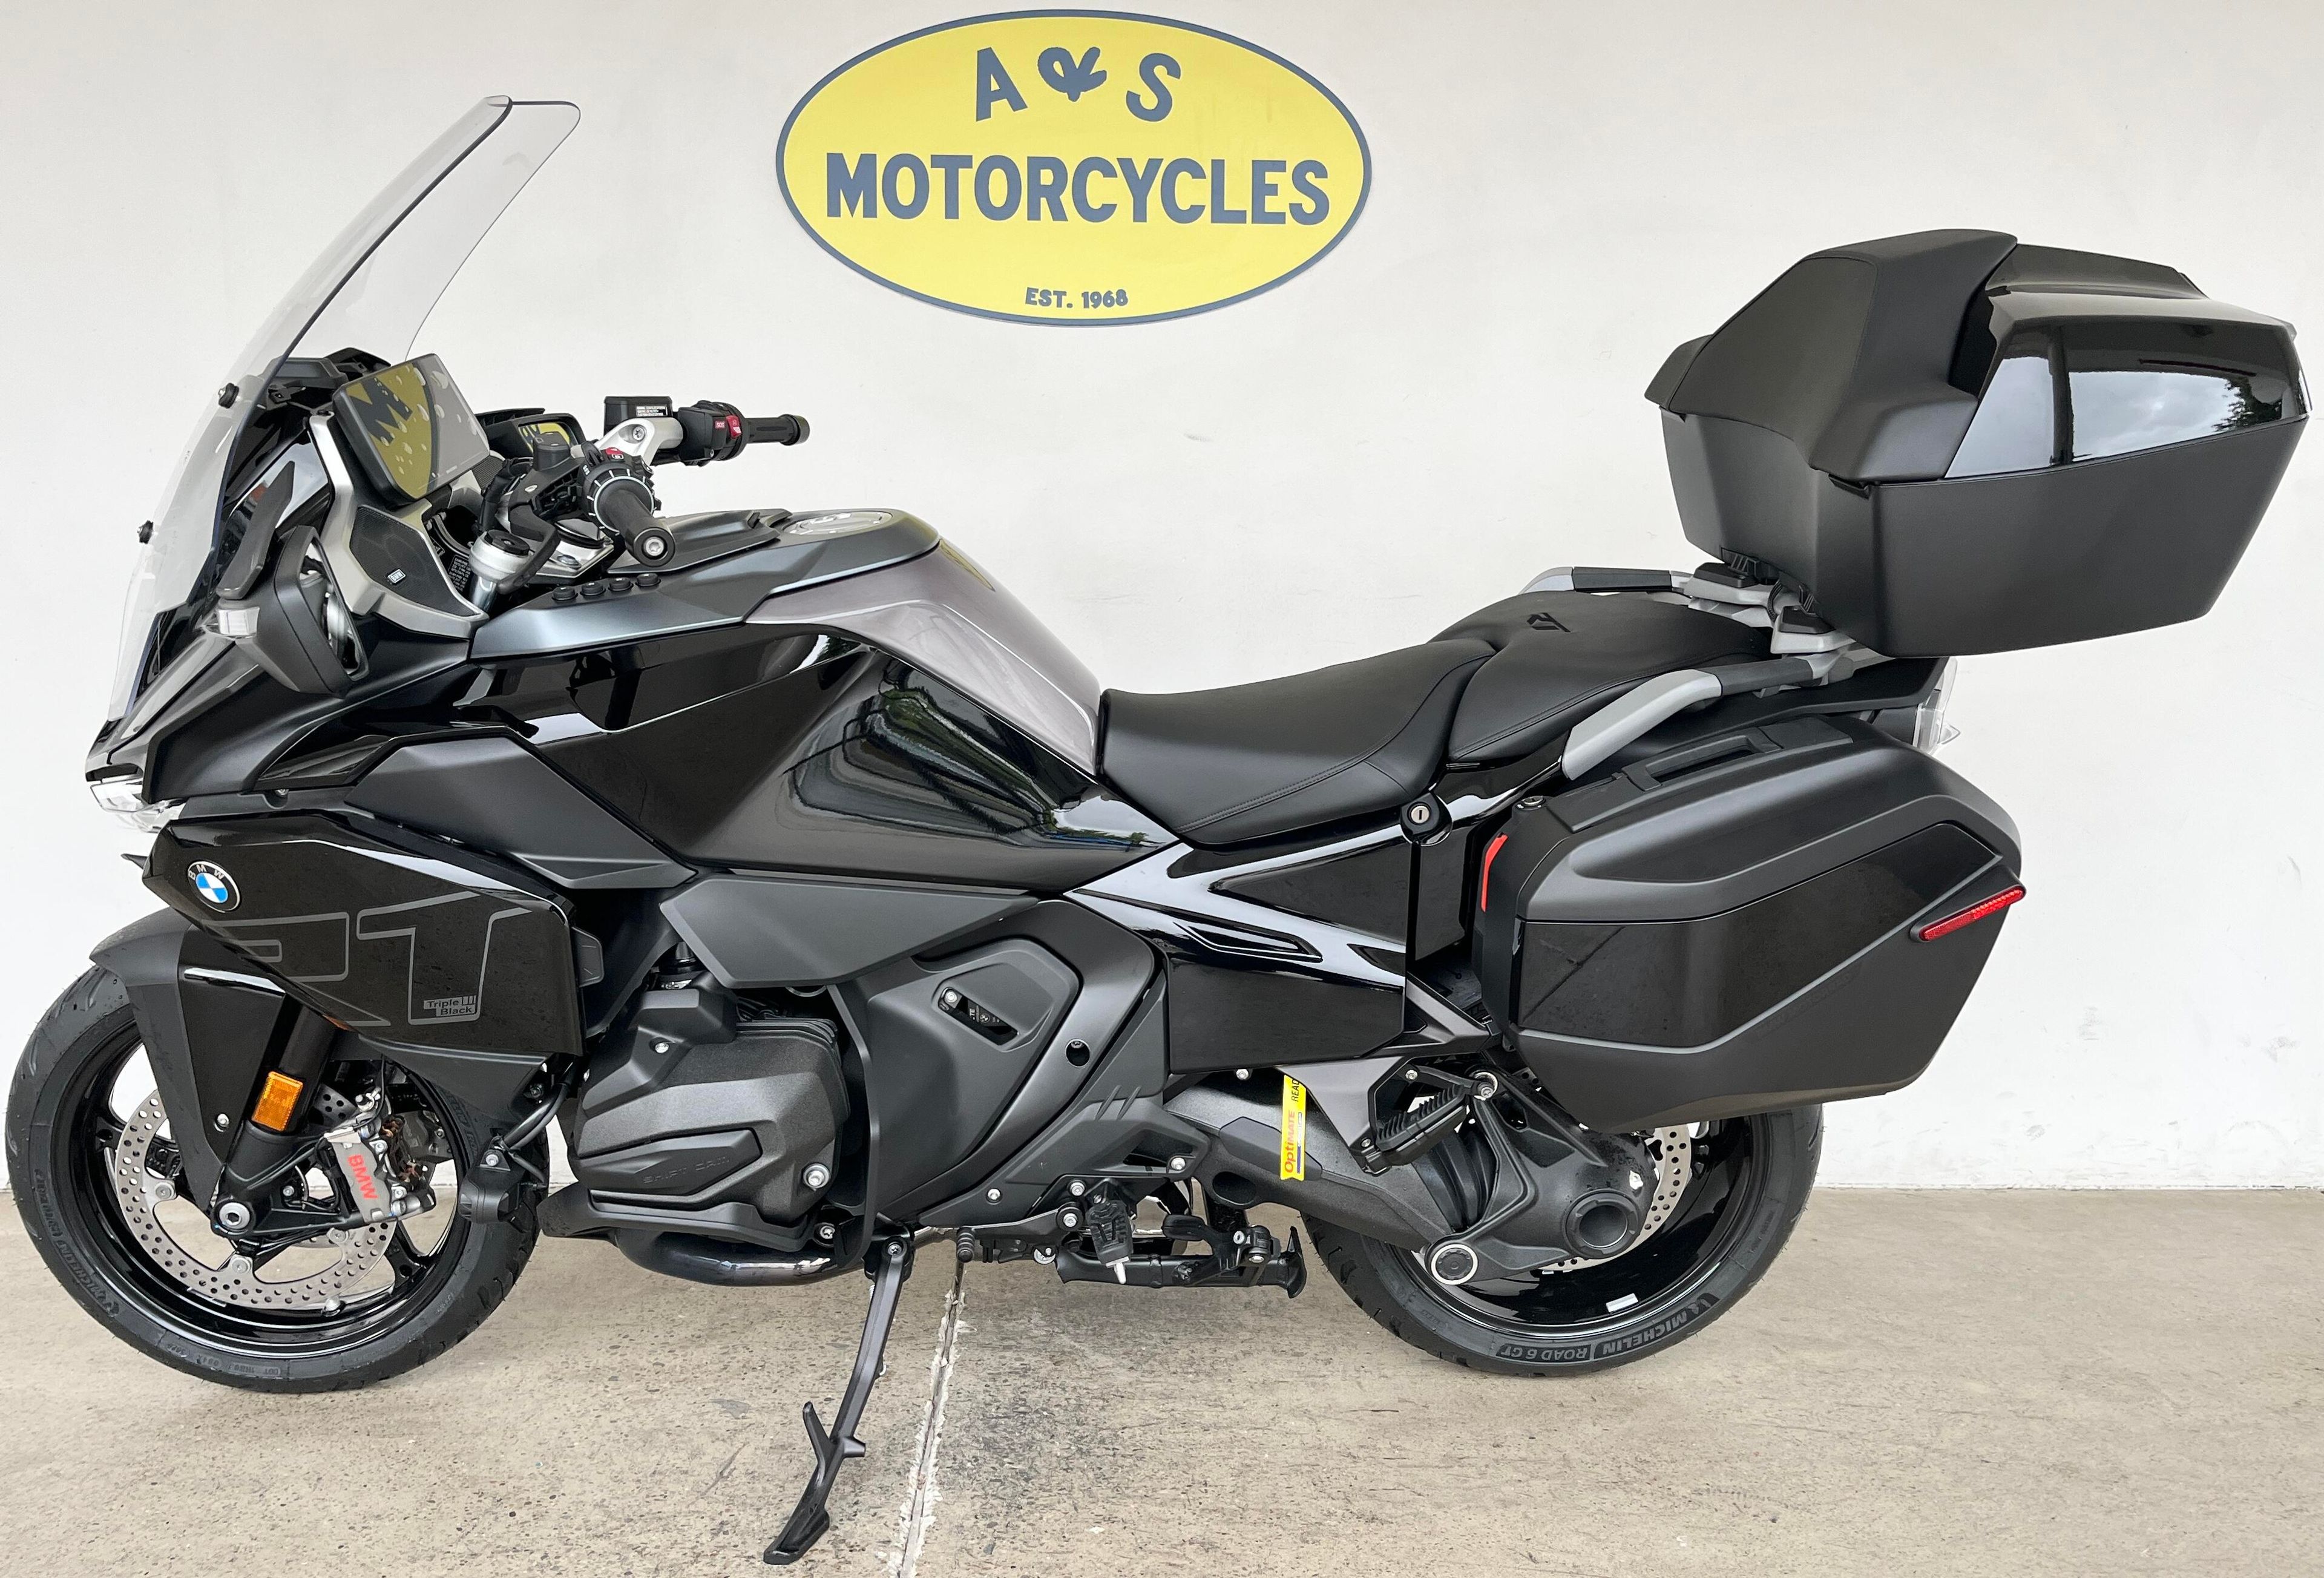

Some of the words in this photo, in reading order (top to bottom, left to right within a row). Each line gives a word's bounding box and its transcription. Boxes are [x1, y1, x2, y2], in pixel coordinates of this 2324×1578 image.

[976, 47, 1028, 121] A
[1126, 52, 1181, 122] S
[826, 153, 1330, 226] MOTORCYCLES
[1025, 287, 1073, 309] EST.
[1082, 289, 1129, 309] 1968
[188, 864, 225, 881] BMW
[427, 999, 459, 1008] Triple
[441, 1006, 472, 1016] Black
[1285, 1110, 1296, 1173] OptiMATE
[347, 1154, 379, 1200] BMW
[1603, 1309, 1688, 1355] MICHELIN
[1500, 1346, 1523, 1358] GT
[1525, 1347, 1538, 1359] 6
[1541, 1347, 1588, 1359] ROAD
